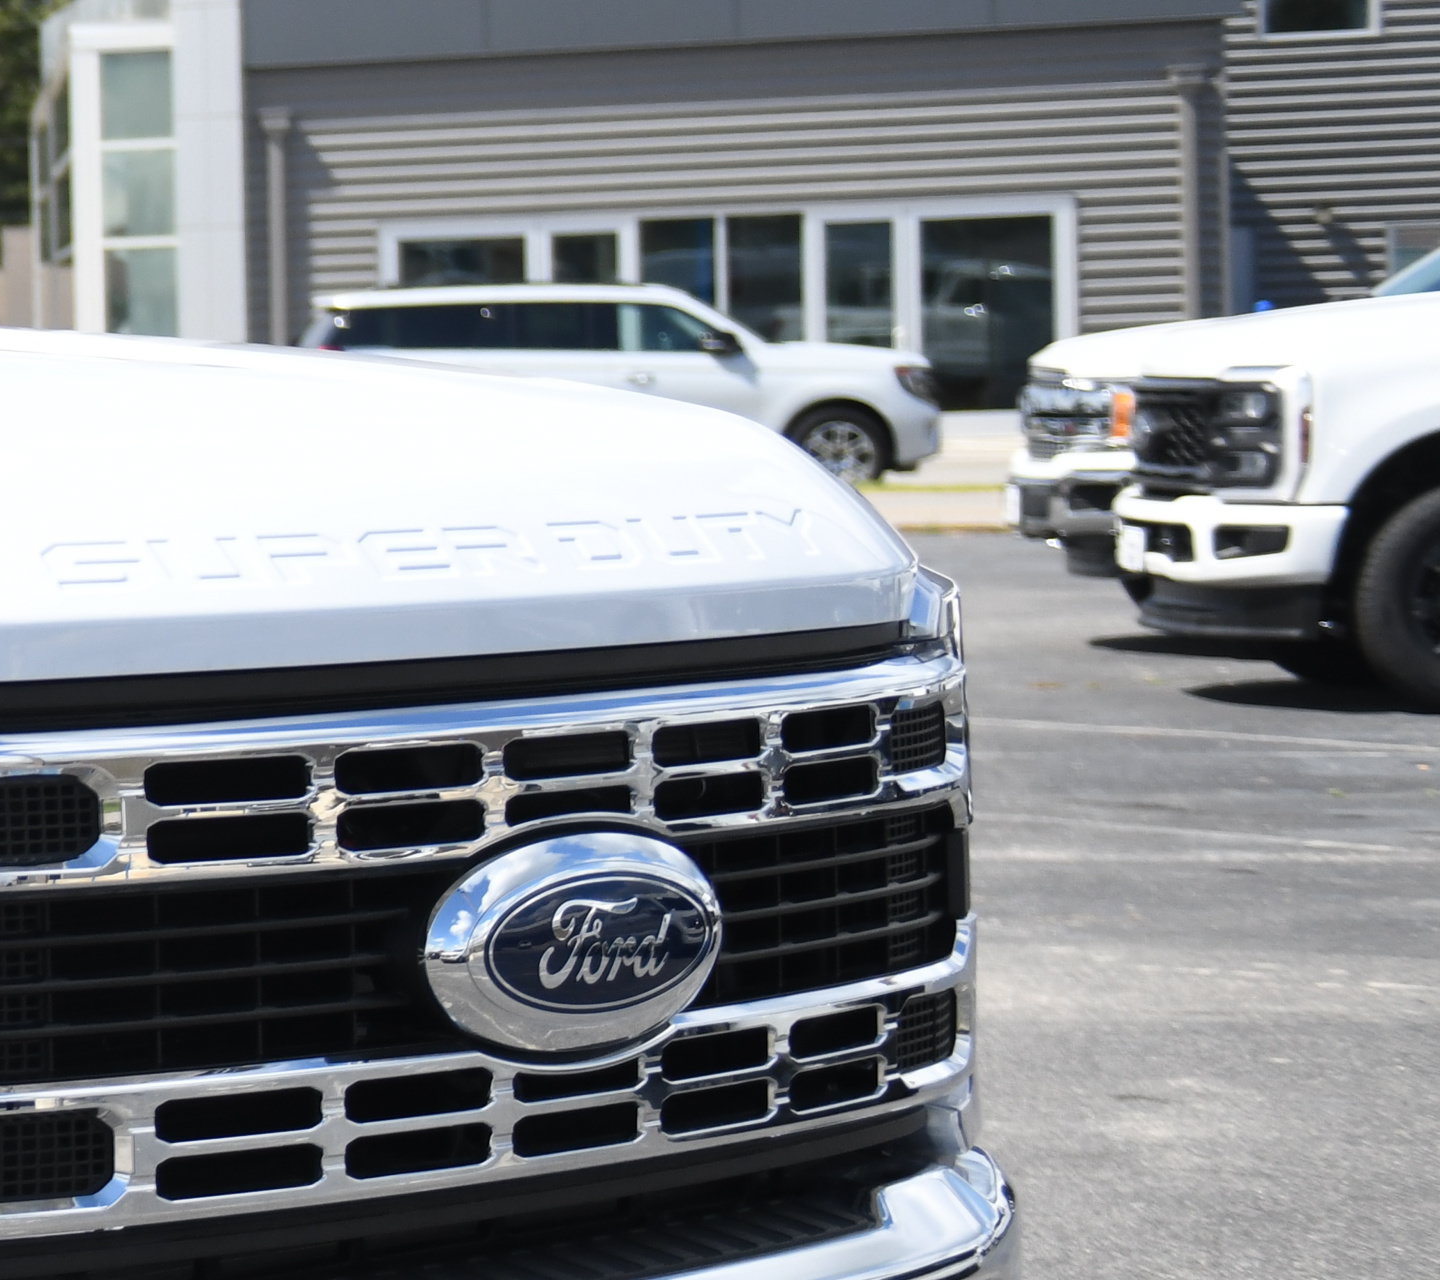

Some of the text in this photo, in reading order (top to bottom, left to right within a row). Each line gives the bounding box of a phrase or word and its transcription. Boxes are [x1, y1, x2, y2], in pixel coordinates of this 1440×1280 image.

[38, 507, 822, 590] SUPER DUTY
[538, 897, 673, 990] Ford
